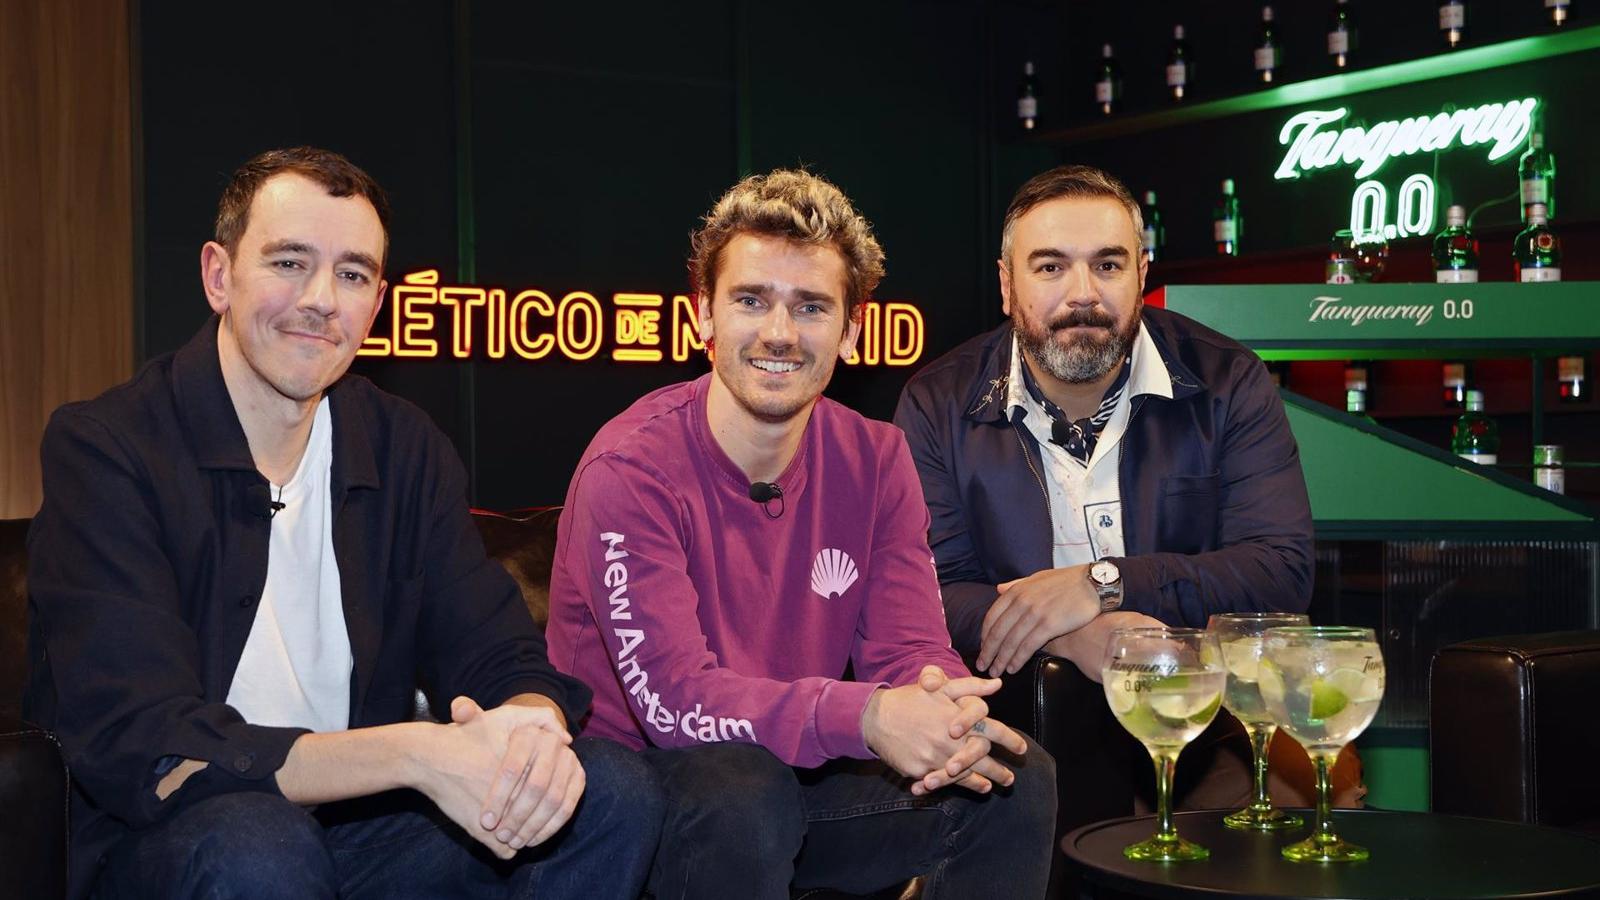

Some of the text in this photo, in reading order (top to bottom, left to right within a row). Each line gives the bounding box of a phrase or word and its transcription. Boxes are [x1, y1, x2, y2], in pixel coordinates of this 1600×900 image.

[1274, 97, 1537, 179] Tanqueray
[1350, 173, 1435, 243] 0.0
[616, 309, 661, 345] DE
[1308, 296, 1474, 327] Tanqueray 0.0
[600, 531, 632, 620] New
